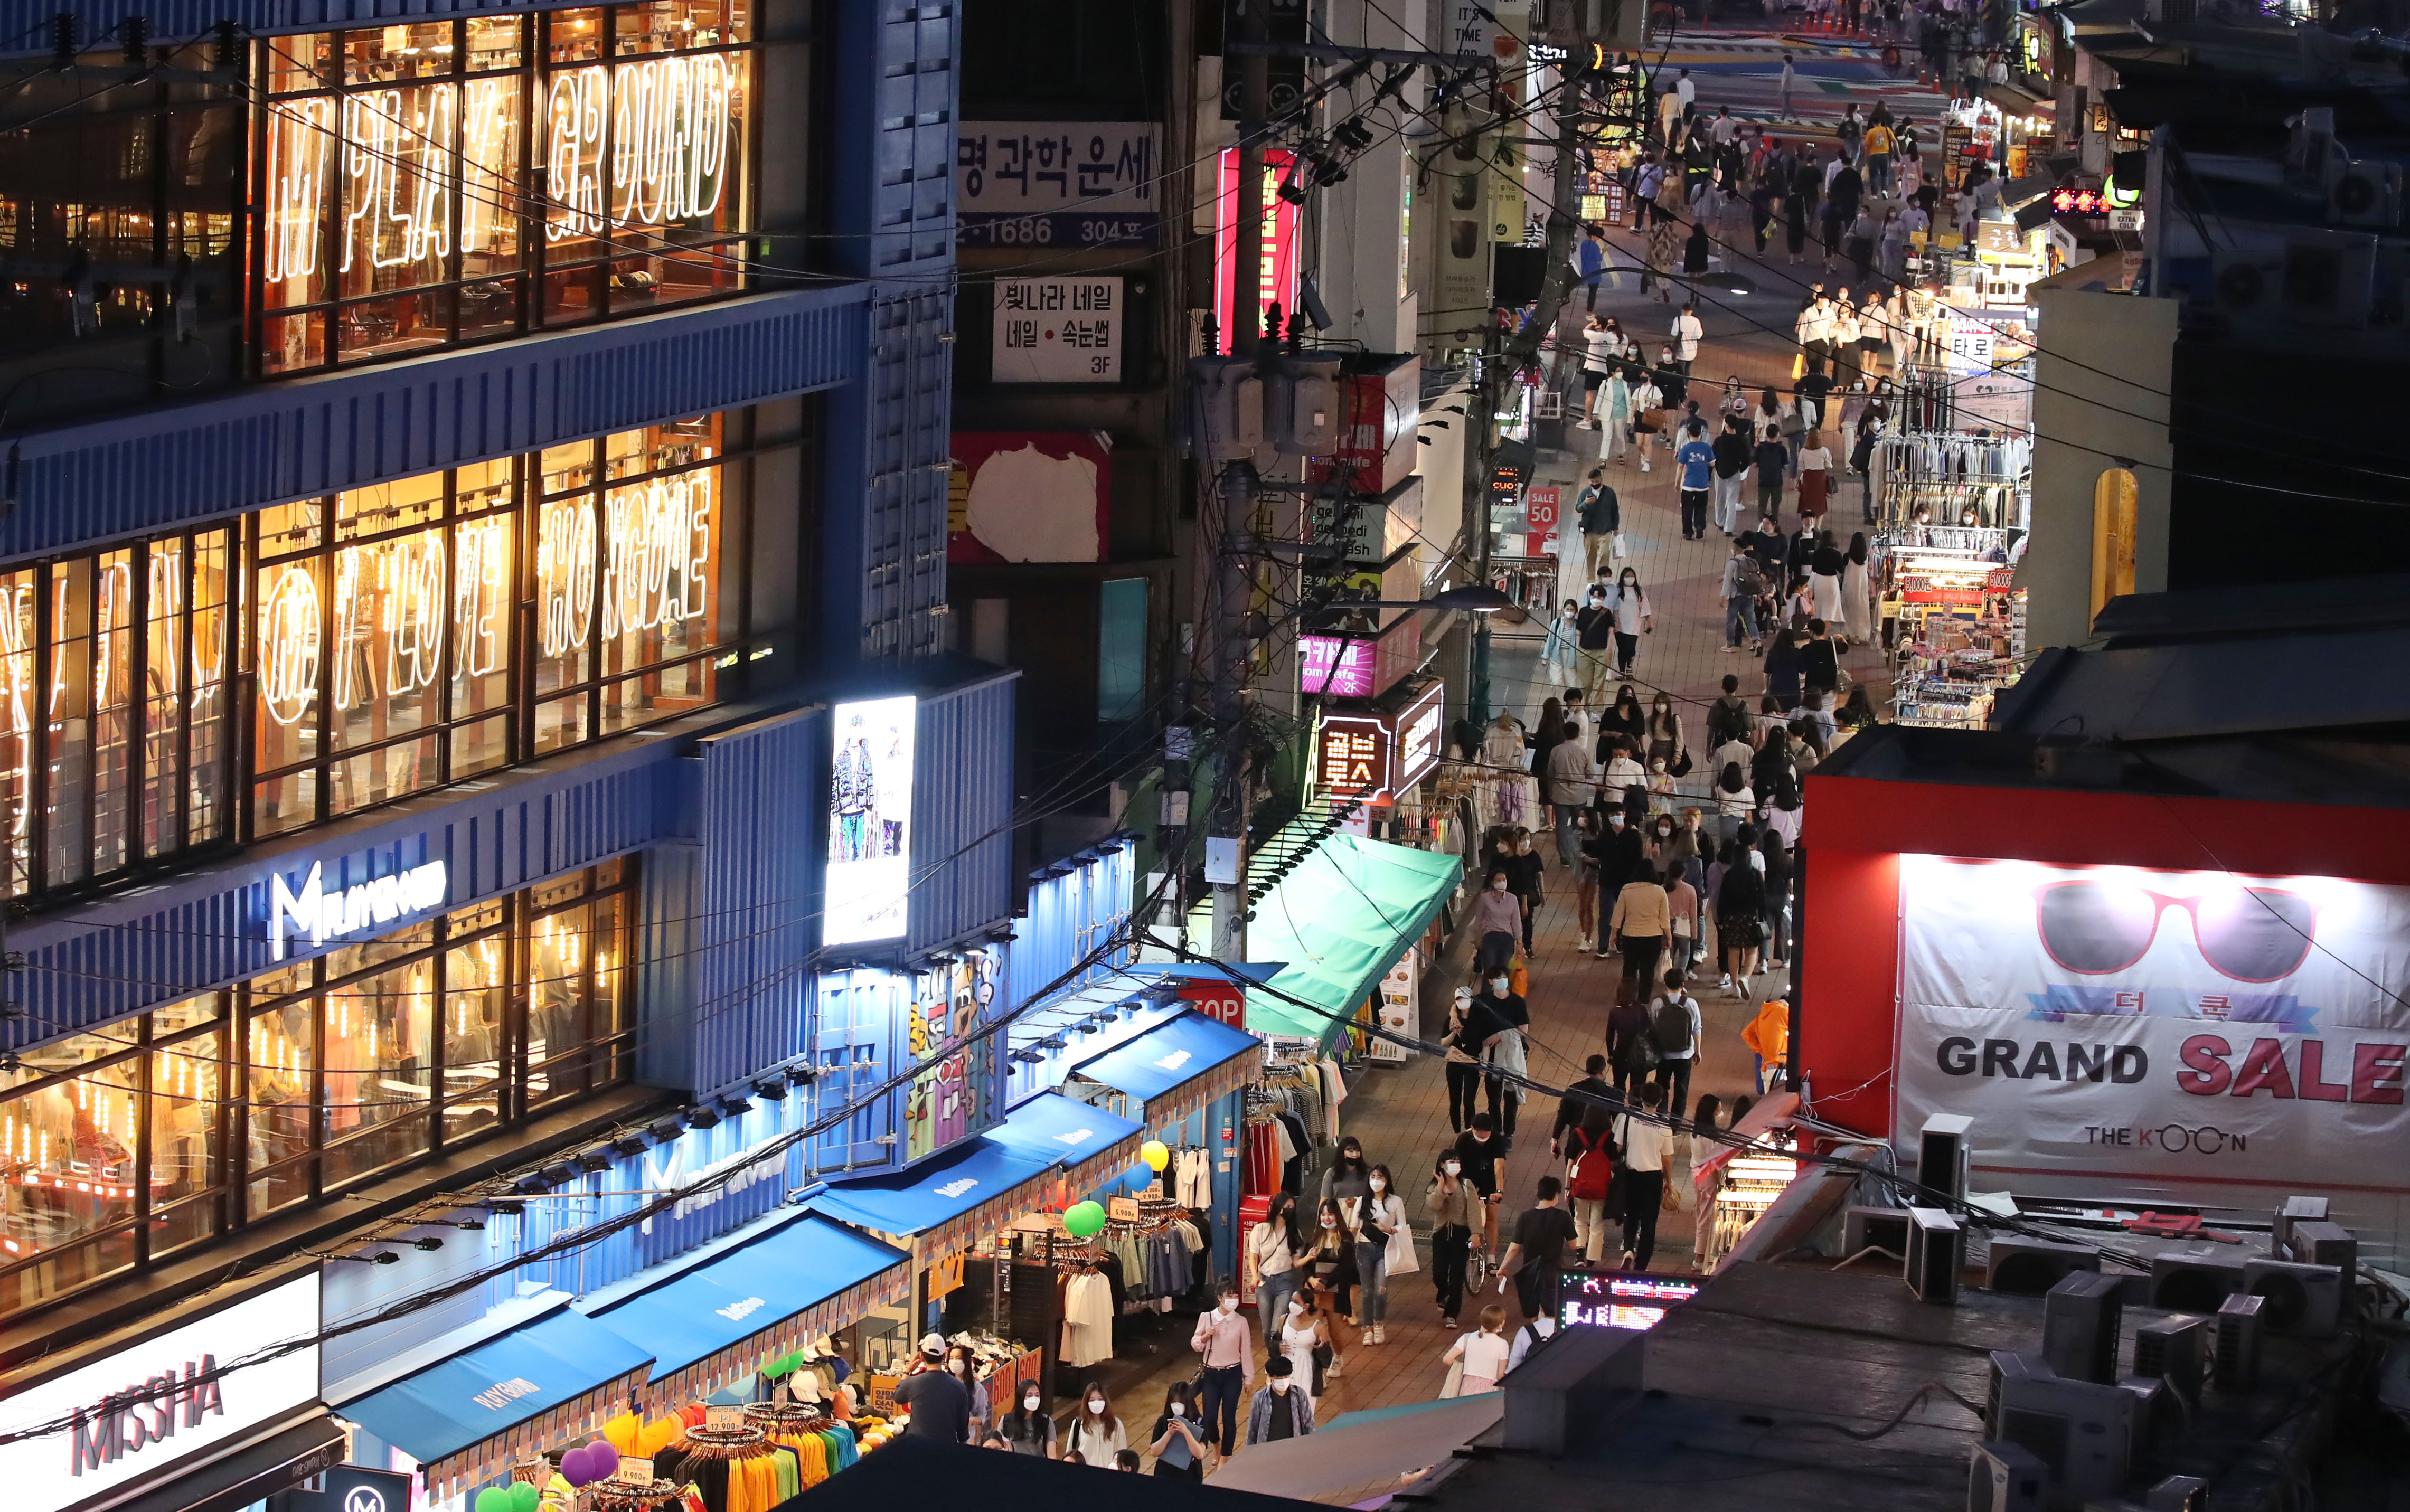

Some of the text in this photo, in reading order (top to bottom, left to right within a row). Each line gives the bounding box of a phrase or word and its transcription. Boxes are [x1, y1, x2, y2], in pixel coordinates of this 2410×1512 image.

[1455, 28, 1482, 42] TIME
[340, 81, 497, 273] PLAY
[545, 53, 728, 243] GROUND
[1081, 220, 1143, 241] 304호
[1006, 284, 1112, 311] 빛나라 네일
[1005, 319, 1109, 348] 네일 속눈썹
[1954, 337, 1989, 357] 타로
[1091, 356, 1112, 374] 3F
[1532, 493, 1555, 503] SALE
[387, 516, 501, 695] LOVE
[544, 474, 711, 657] HONGDAE
[1344, 682, 1357, 693] 2F
[2116, 990, 2232, 1017] 더 쿤
[1937, 1034, 2407, 1105] GRAND SALE
[2085, 1123, 2246, 1155] THE KOON
[70, 1353, 225, 1478] MISSHA
